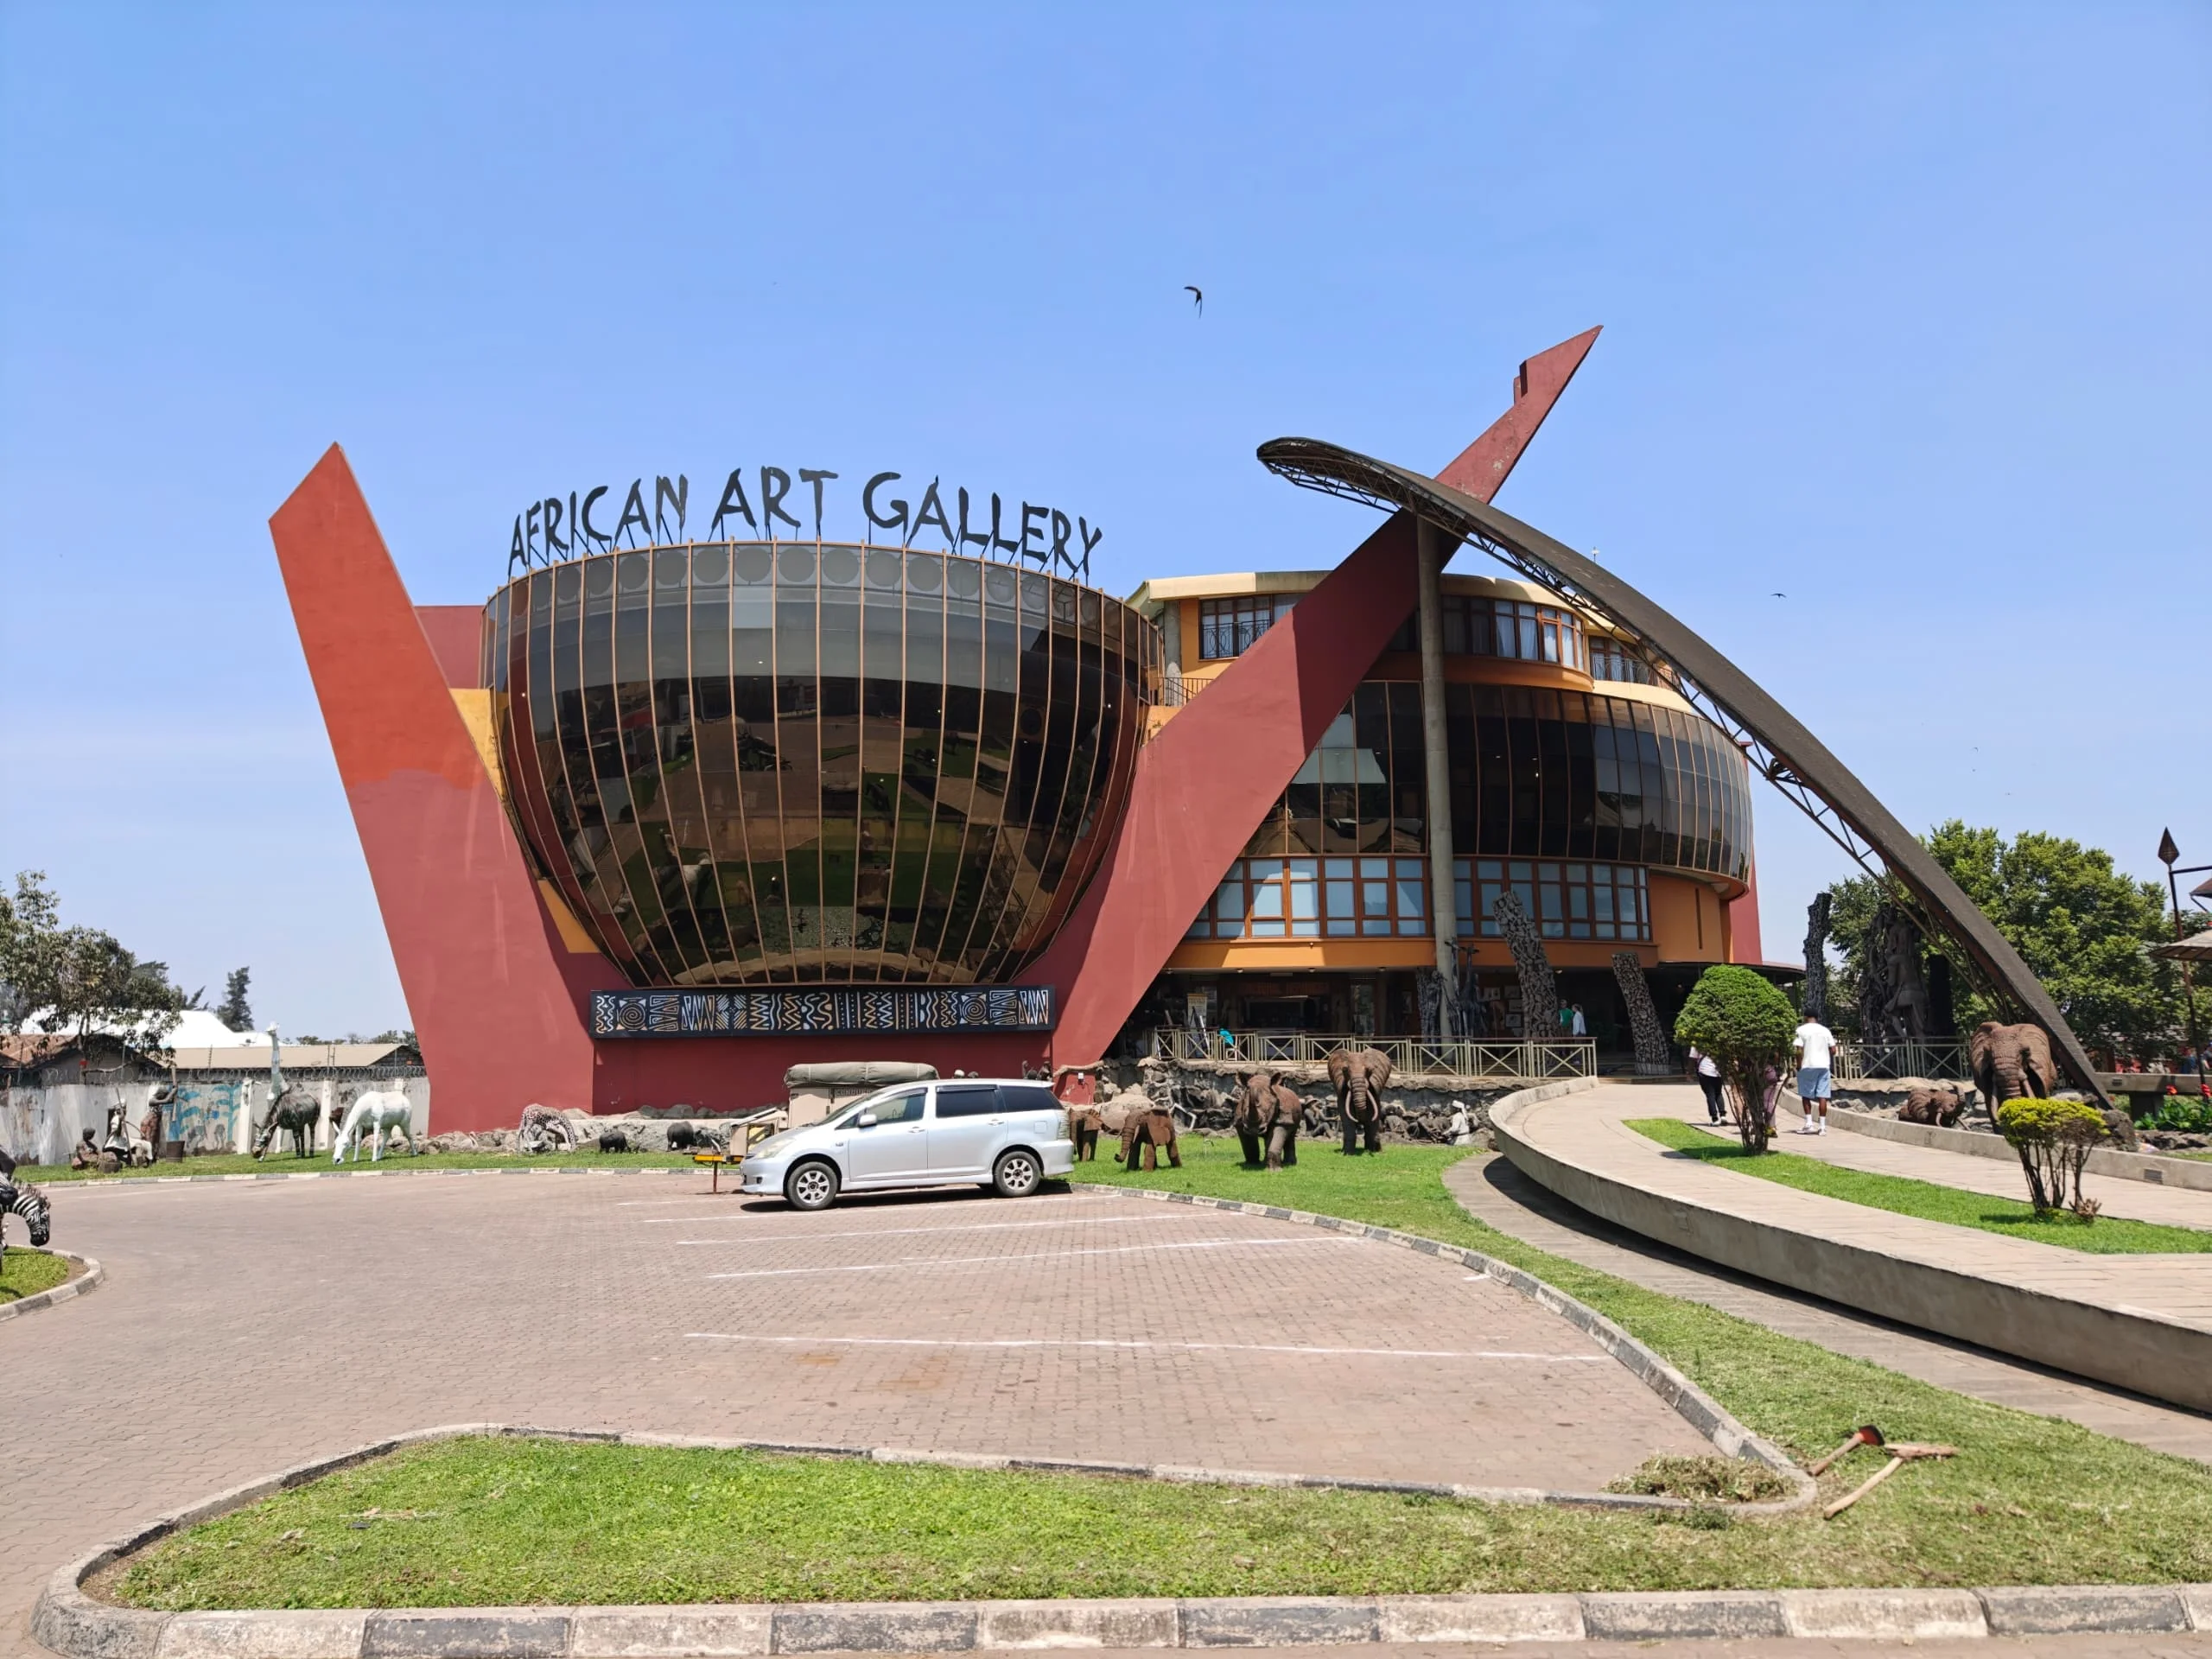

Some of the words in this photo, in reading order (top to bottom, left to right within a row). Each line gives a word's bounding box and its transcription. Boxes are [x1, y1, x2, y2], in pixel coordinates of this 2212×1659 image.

[508, 474, 689, 569] AFRICAN
[711, 465, 839, 530] ART
[862, 471, 1103, 575] GALLERY
